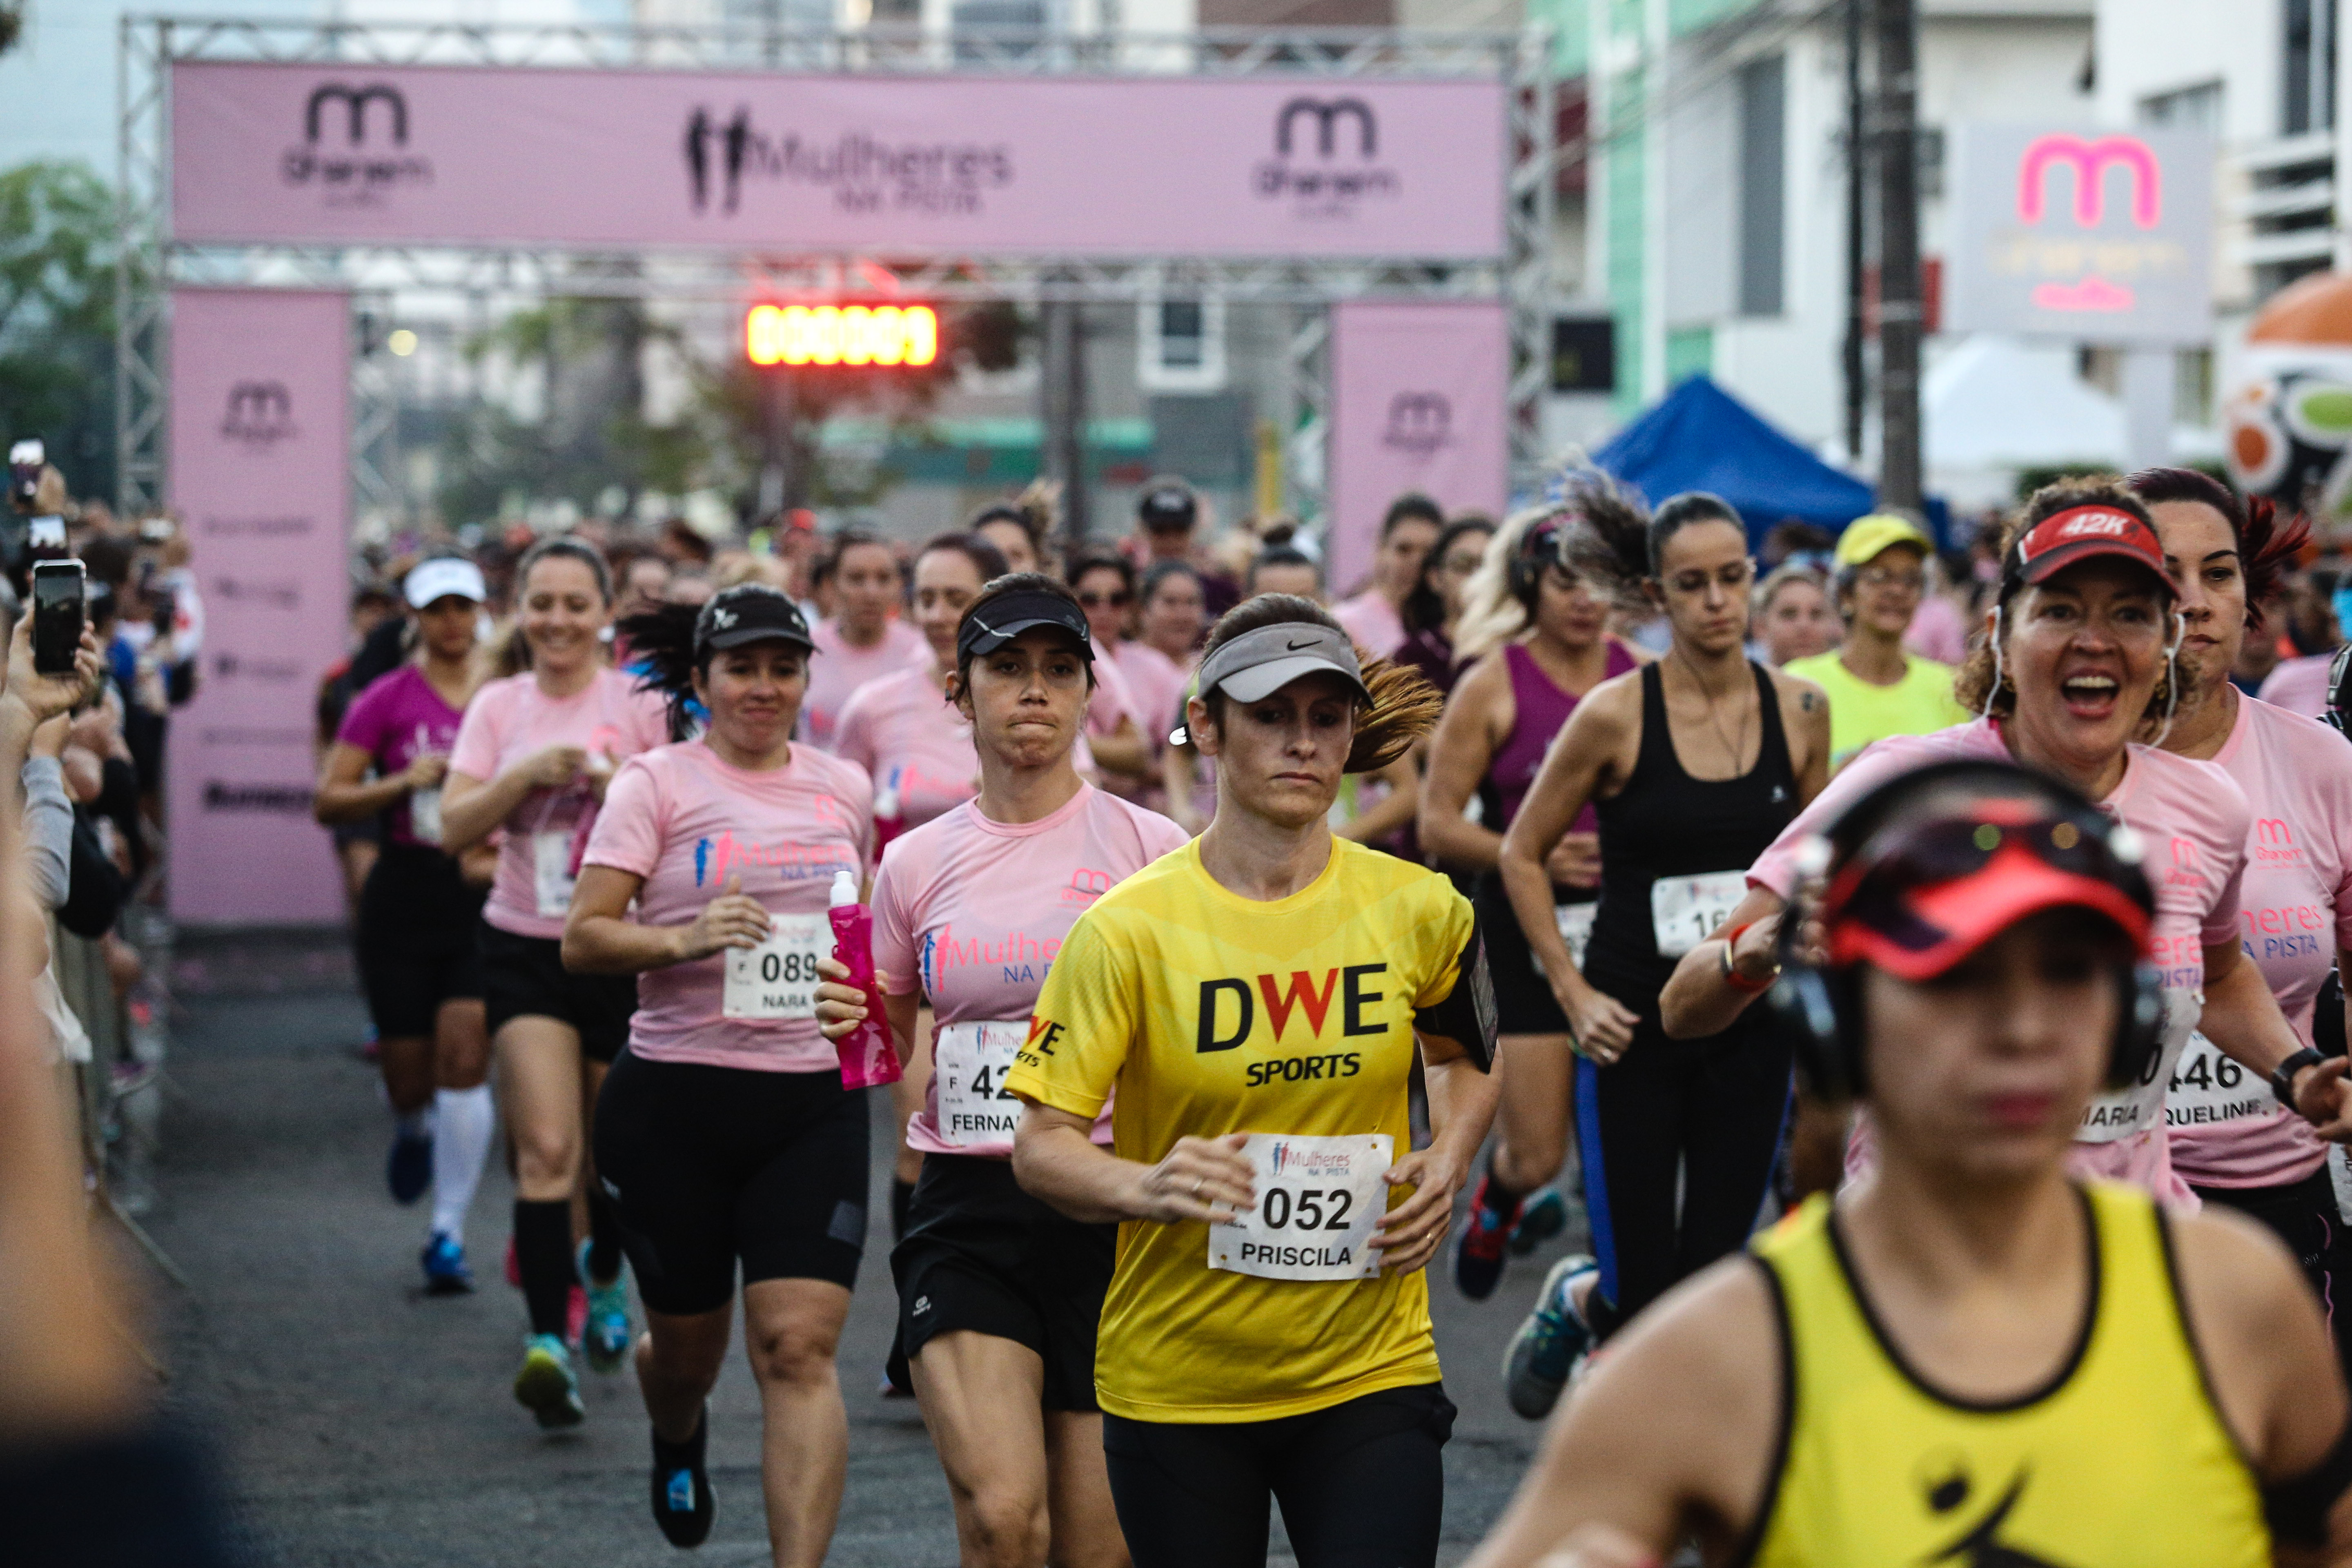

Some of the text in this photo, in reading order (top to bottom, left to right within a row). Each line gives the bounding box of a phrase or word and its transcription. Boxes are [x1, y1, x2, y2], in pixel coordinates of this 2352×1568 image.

[2060, 512, 2128, 535] 42K
[949, 931, 1062, 968] Mulhe
[2265, 934, 2319, 958] PISTA
[762, 953, 816, 982] 089
[1004, 964, 1034, 982] NA
[763, 994, 807, 1007] NARA
[1197, 963, 1388, 1053] DWE
[1246, 1052, 1361, 1087] SPORTS
[953, 1114, 1020, 1131] FERNA
[2165, 1099, 2261, 1126] QUELINE
[1287, 1151, 1350, 1167] Mulheres
[1264, 1188, 1352, 1230] 052
[1242, 1242, 1351, 1266] PRISCILA
